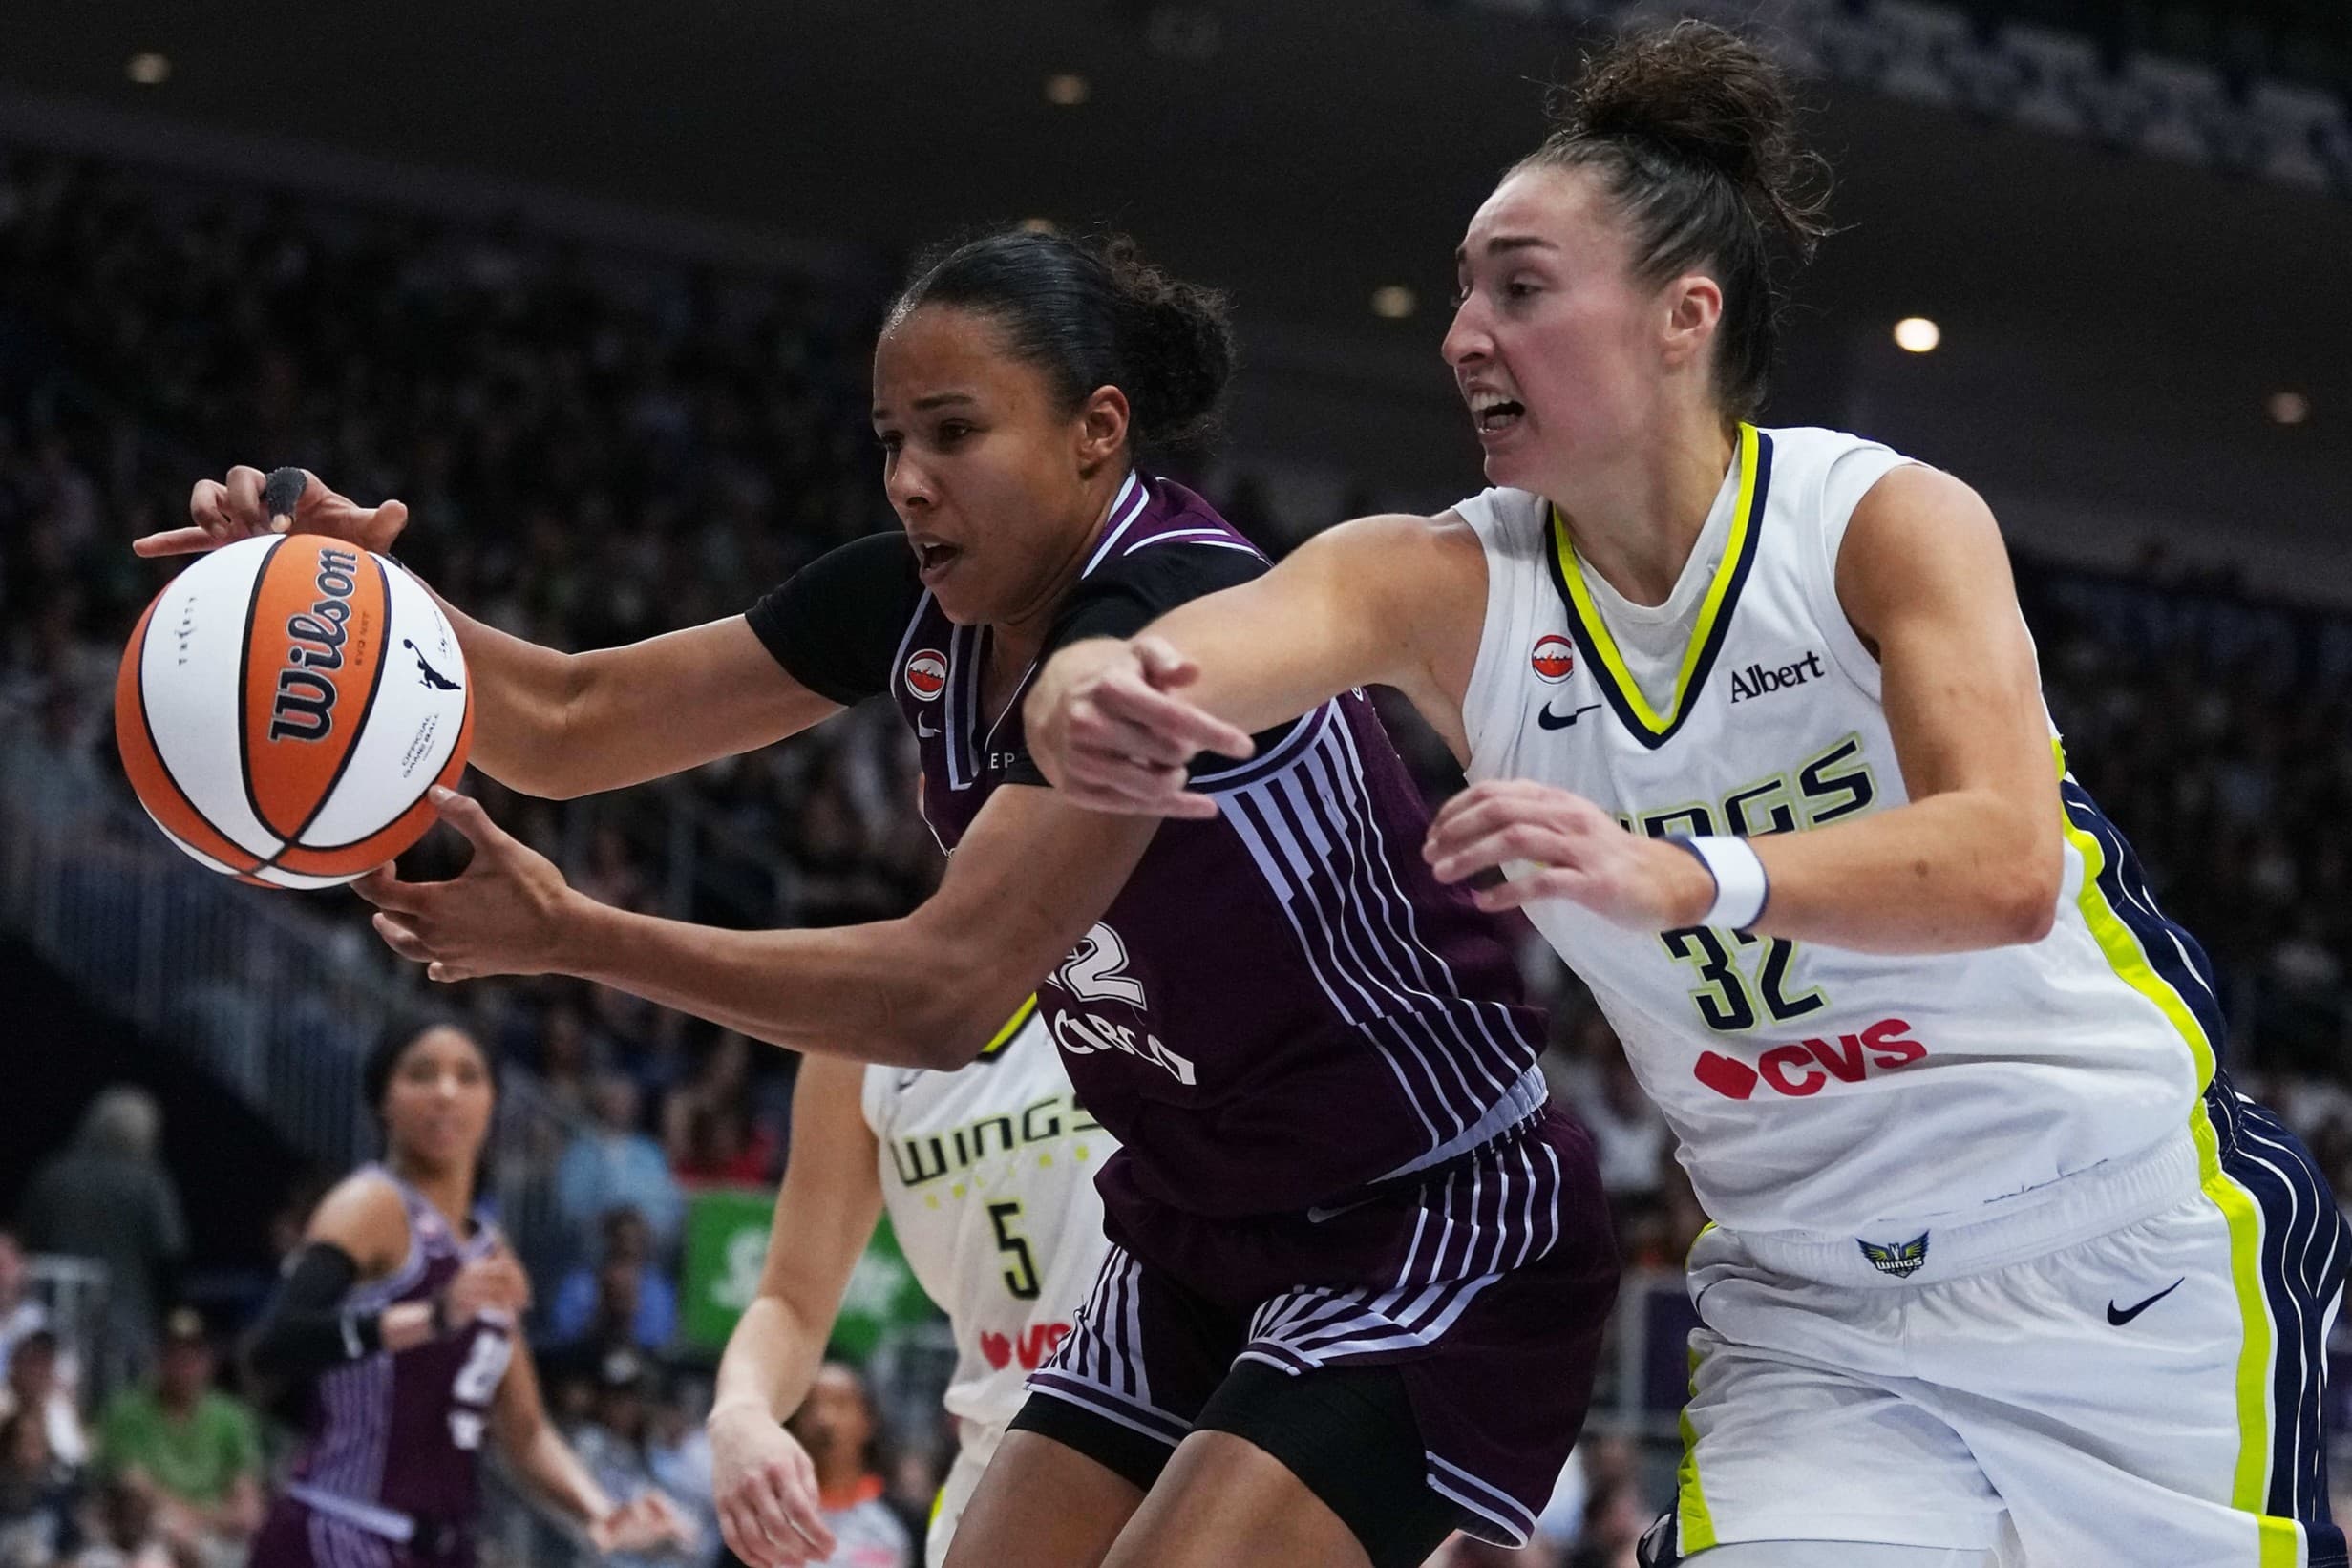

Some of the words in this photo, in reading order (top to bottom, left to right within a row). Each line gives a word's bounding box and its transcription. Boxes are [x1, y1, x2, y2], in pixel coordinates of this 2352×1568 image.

[268, 548, 358, 744] Wilson
[1729, 650, 1825, 704] Albert
[1657, 924, 1832, 1033] 32
[1758, 1018, 1928, 1097] CVS
[986, 1199, 1042, 1302] 5
[1875, 1256, 1922, 1270] WINGS
